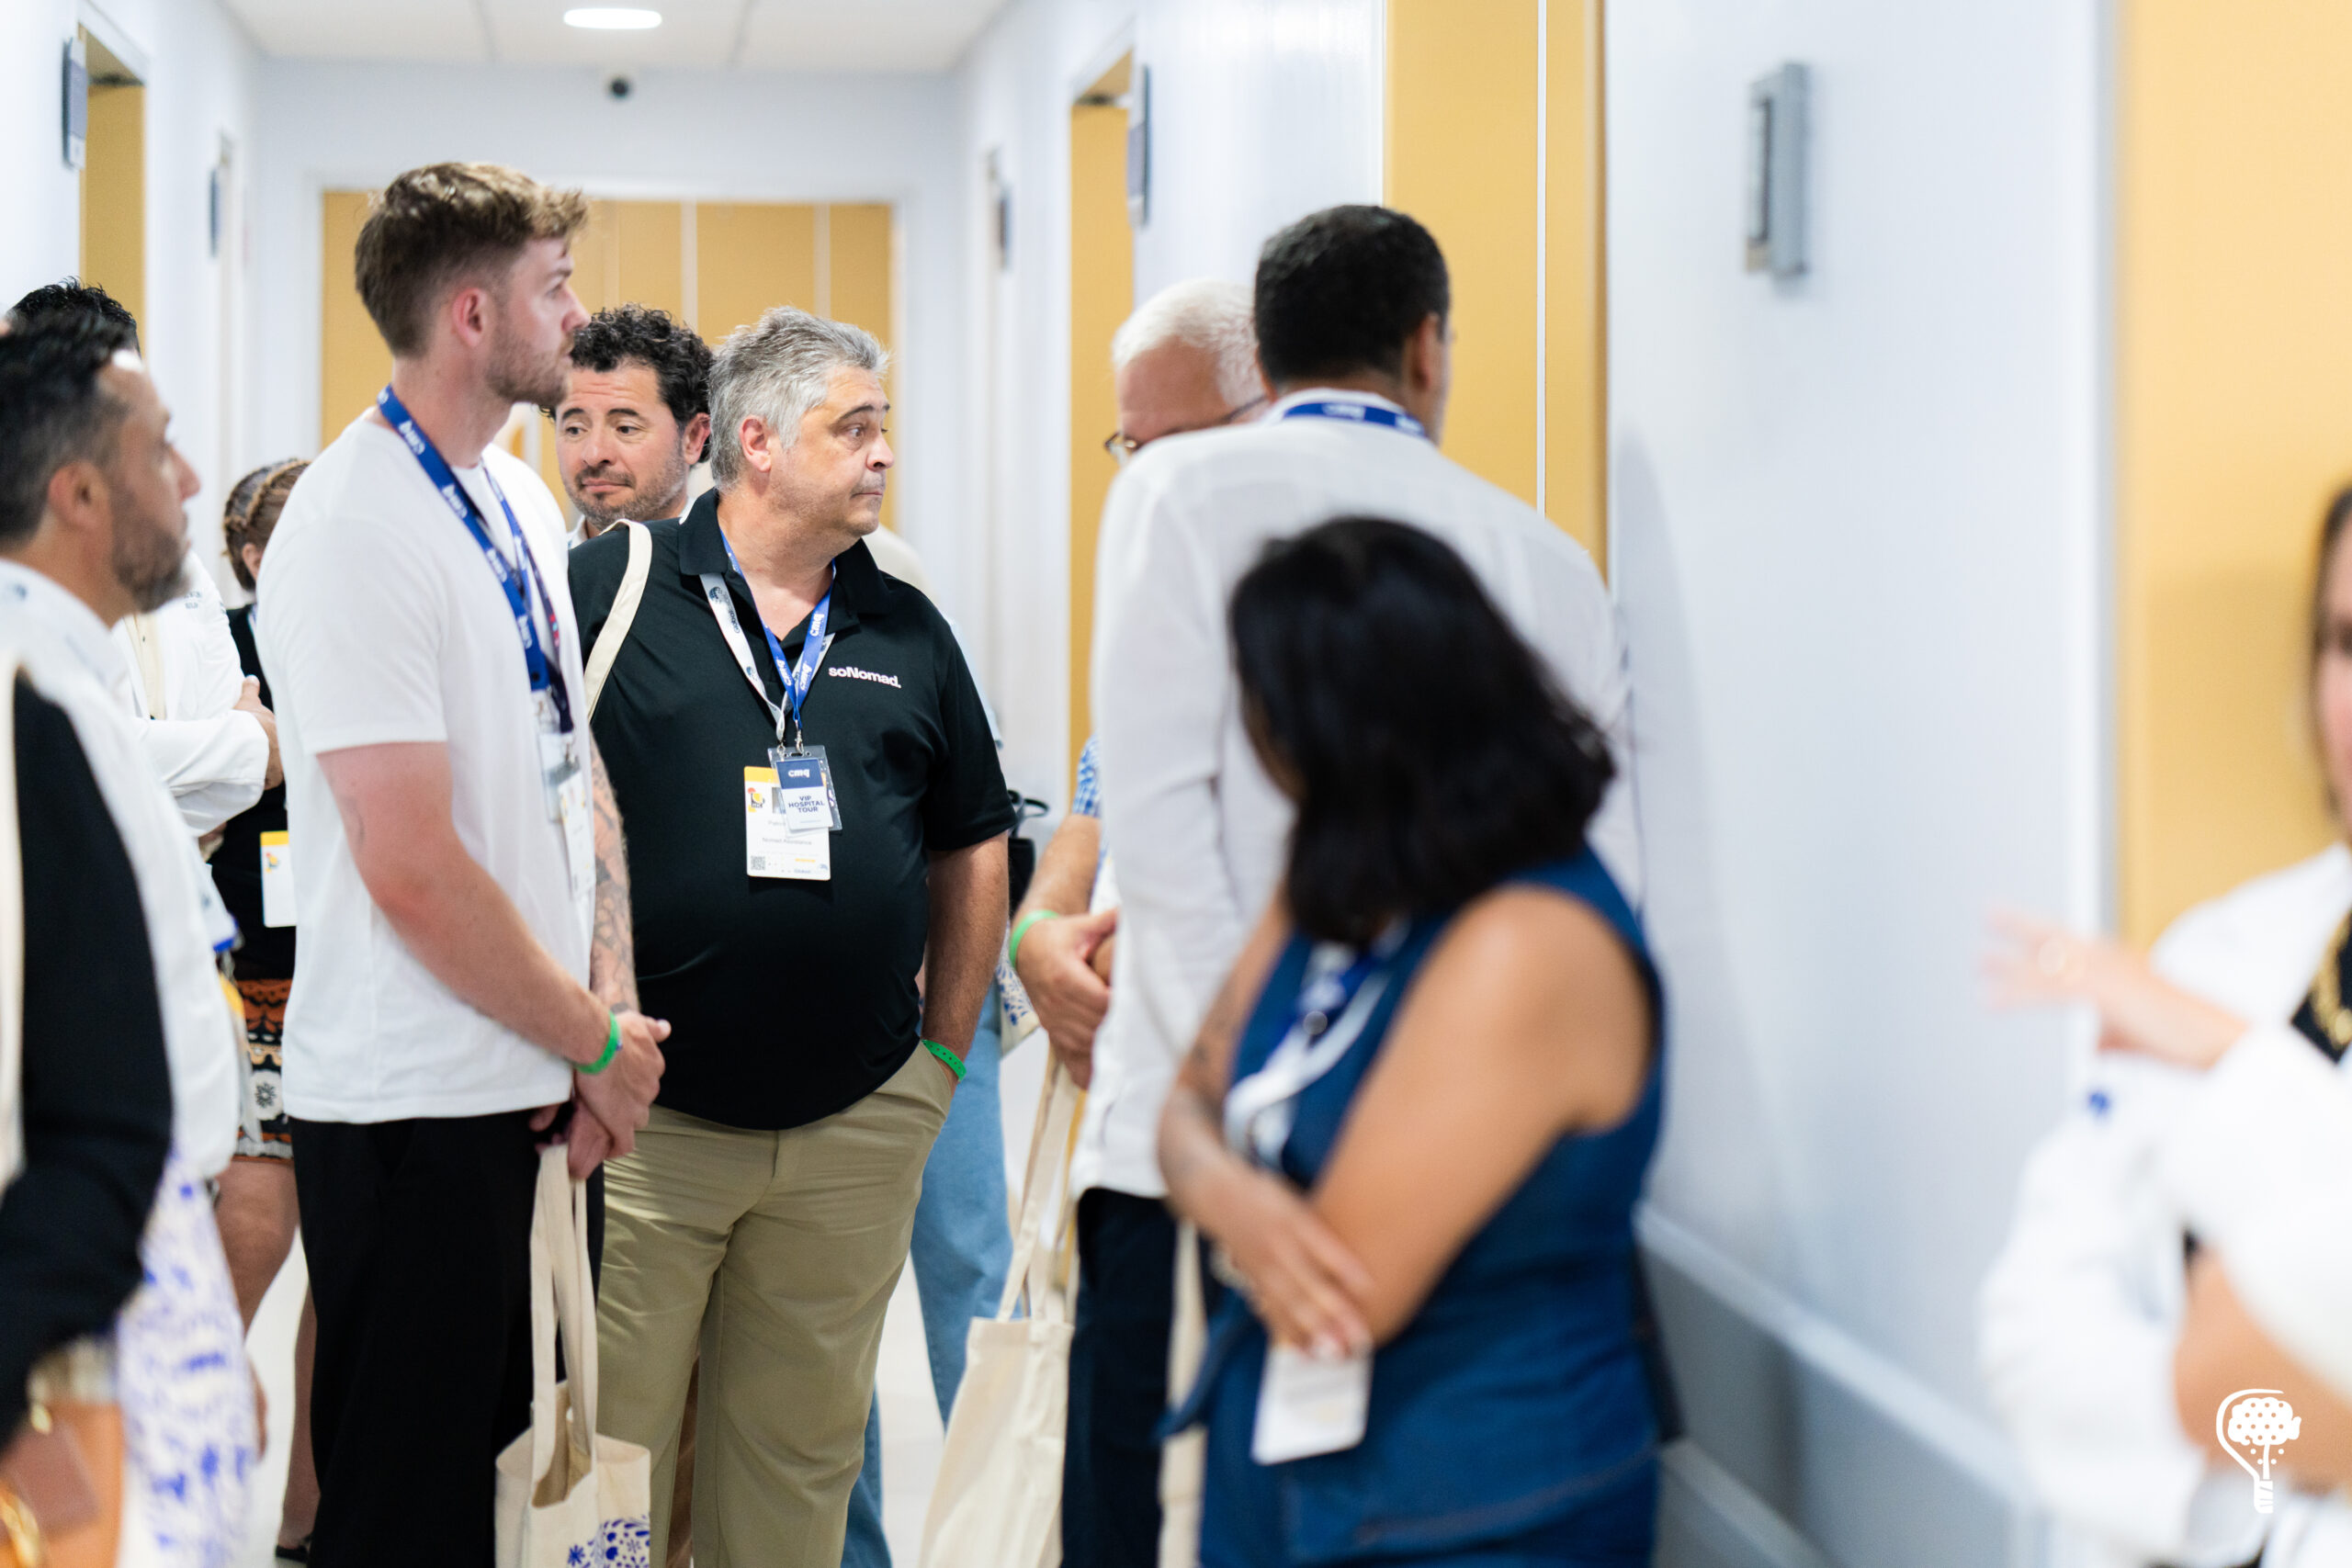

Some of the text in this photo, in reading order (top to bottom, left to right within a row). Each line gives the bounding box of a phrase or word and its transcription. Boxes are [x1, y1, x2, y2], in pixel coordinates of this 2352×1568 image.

[809, 614, 825, 637] cmq
[776, 660, 792, 686] cmq
[800, 662, 812, 690] cmq
[828, 666, 902, 689] soNomad.
[788, 769, 809, 778] cmq
